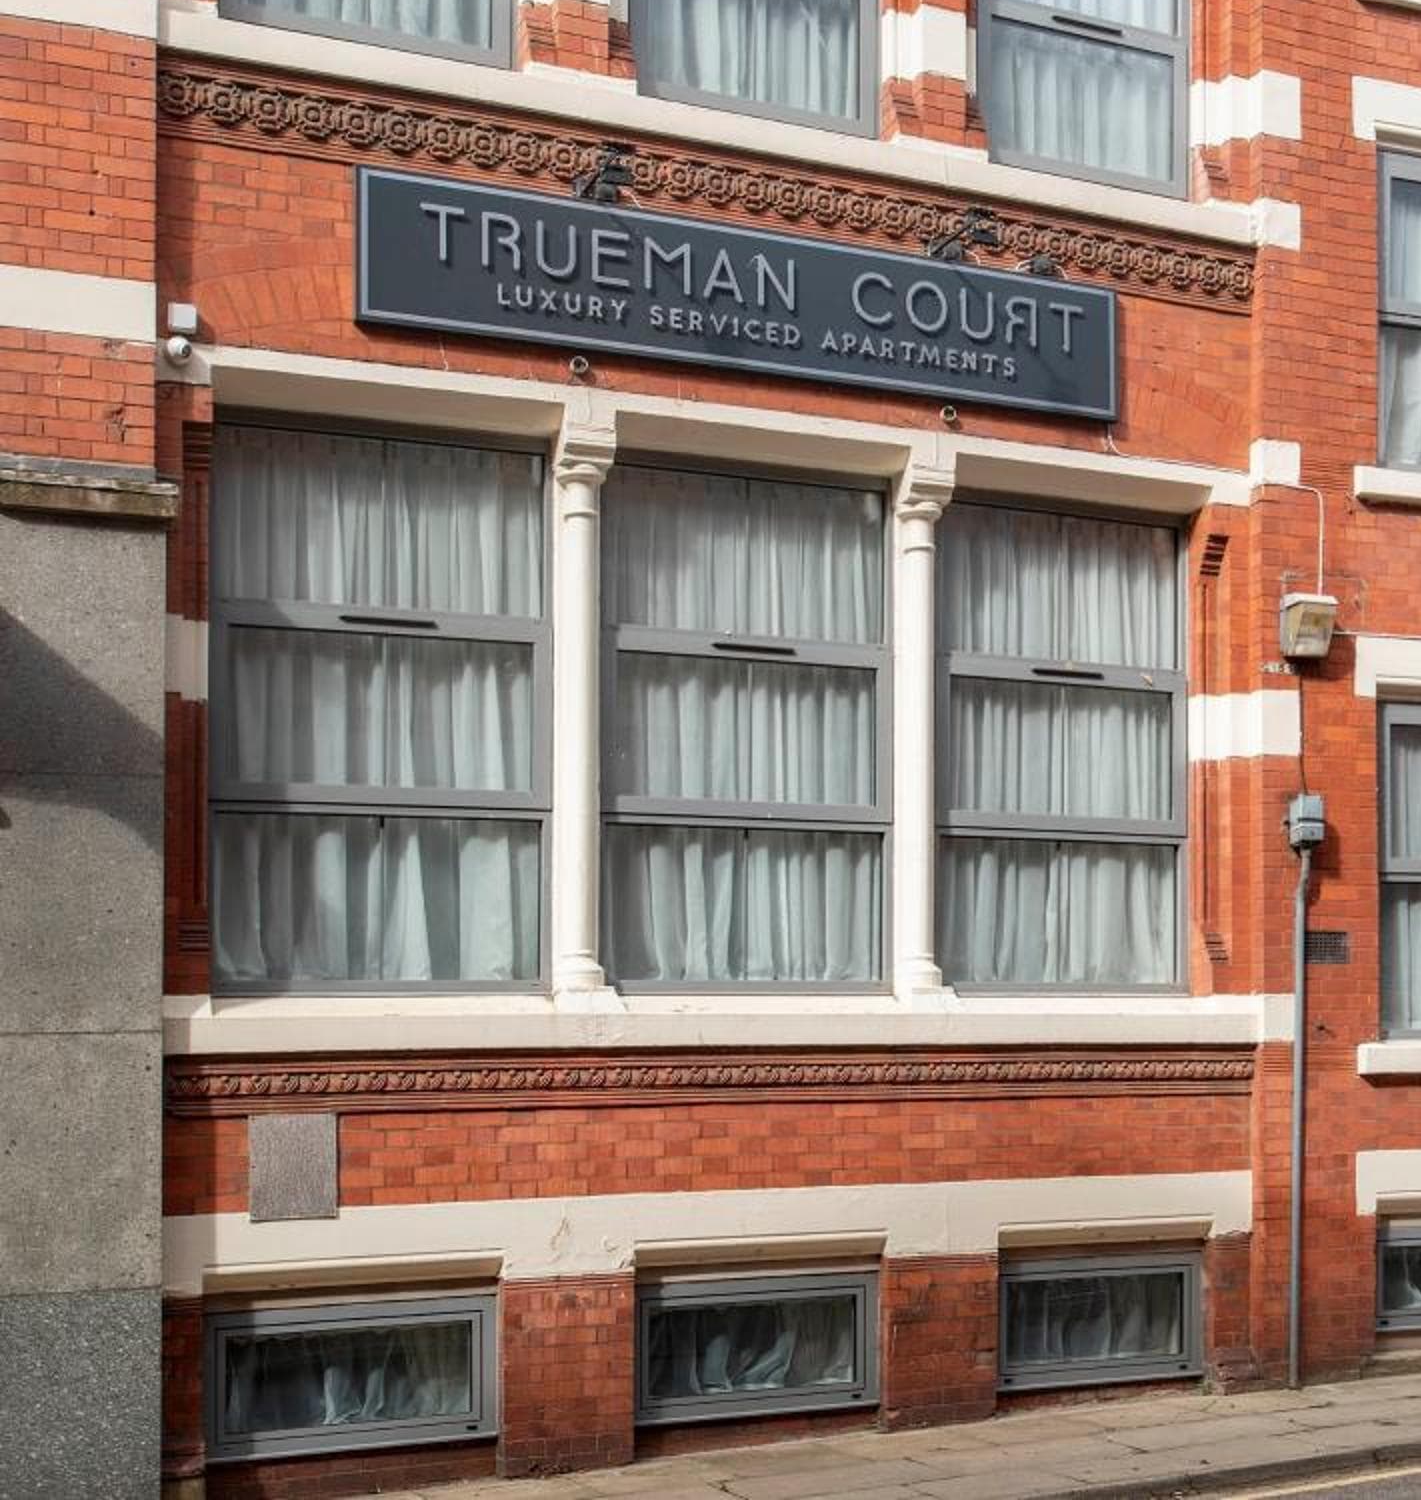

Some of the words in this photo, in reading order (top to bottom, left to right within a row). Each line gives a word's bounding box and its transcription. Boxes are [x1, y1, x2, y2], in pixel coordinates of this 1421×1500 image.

[419, 202, 796, 311] TRUEMAN
[851, 271, 1084, 353] COURT
[496, 283, 627, 321] LUXURY
[650, 304, 800, 346] SERVICED
[820, 329, 1017, 377] APARTMENTS
